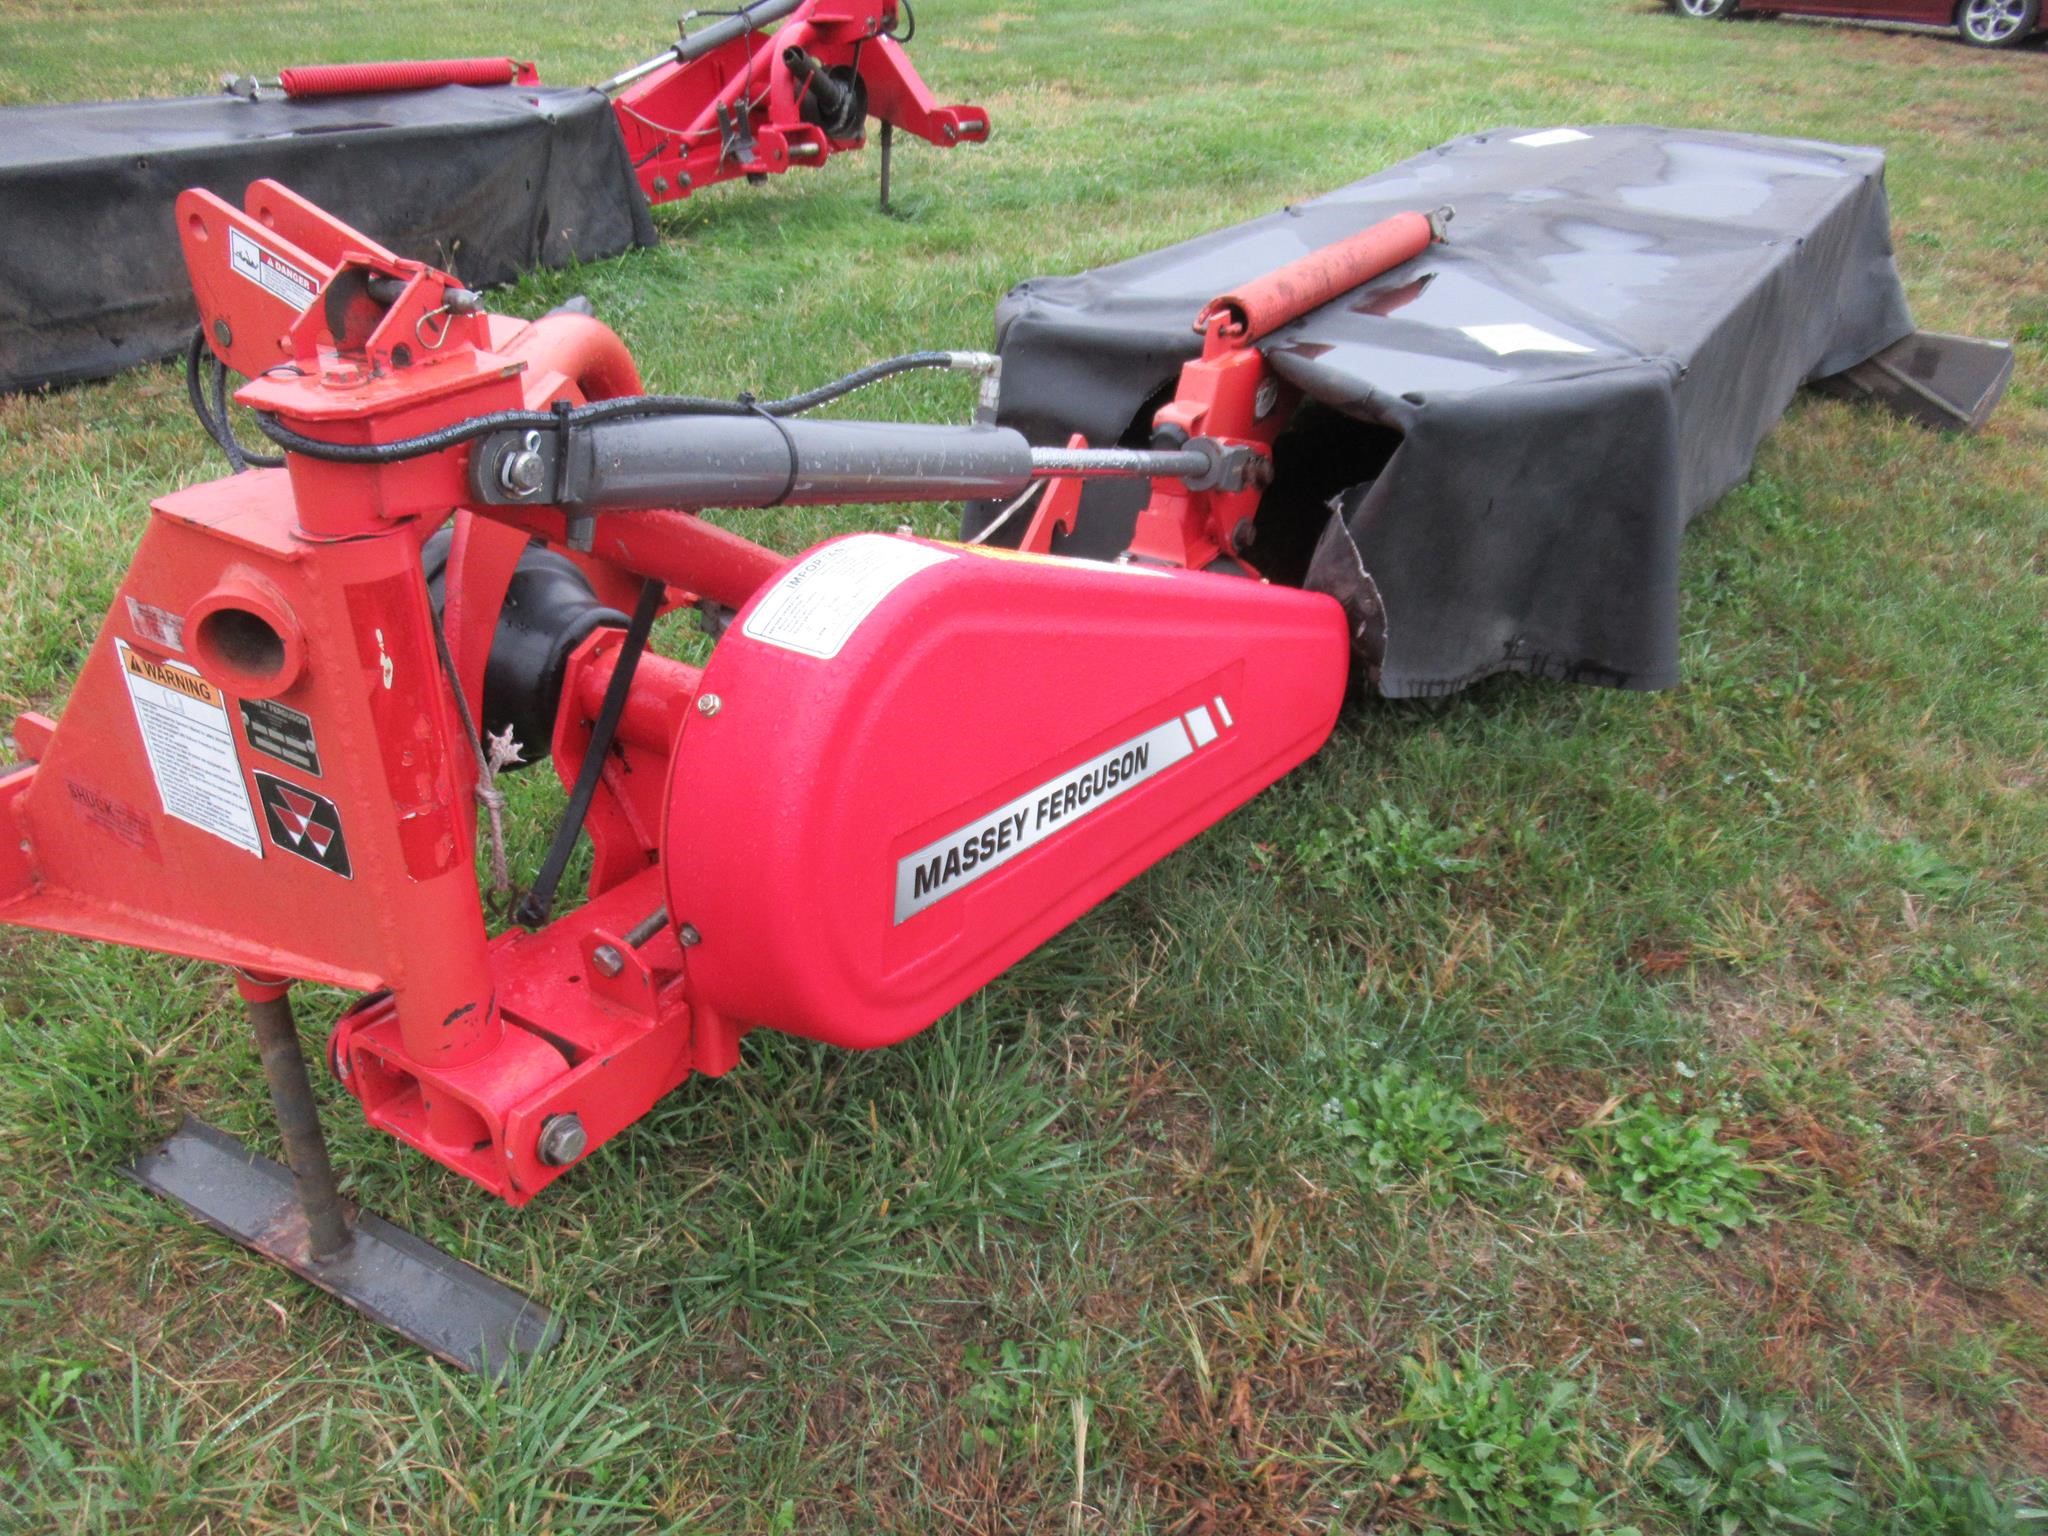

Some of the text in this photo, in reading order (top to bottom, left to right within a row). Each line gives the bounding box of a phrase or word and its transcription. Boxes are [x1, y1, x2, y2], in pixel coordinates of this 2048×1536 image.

[275, 262, 310, 290] DANGER
[144, 663, 211, 700] WARNING
[913, 742, 1150, 899] MASSEY FERGUSON
